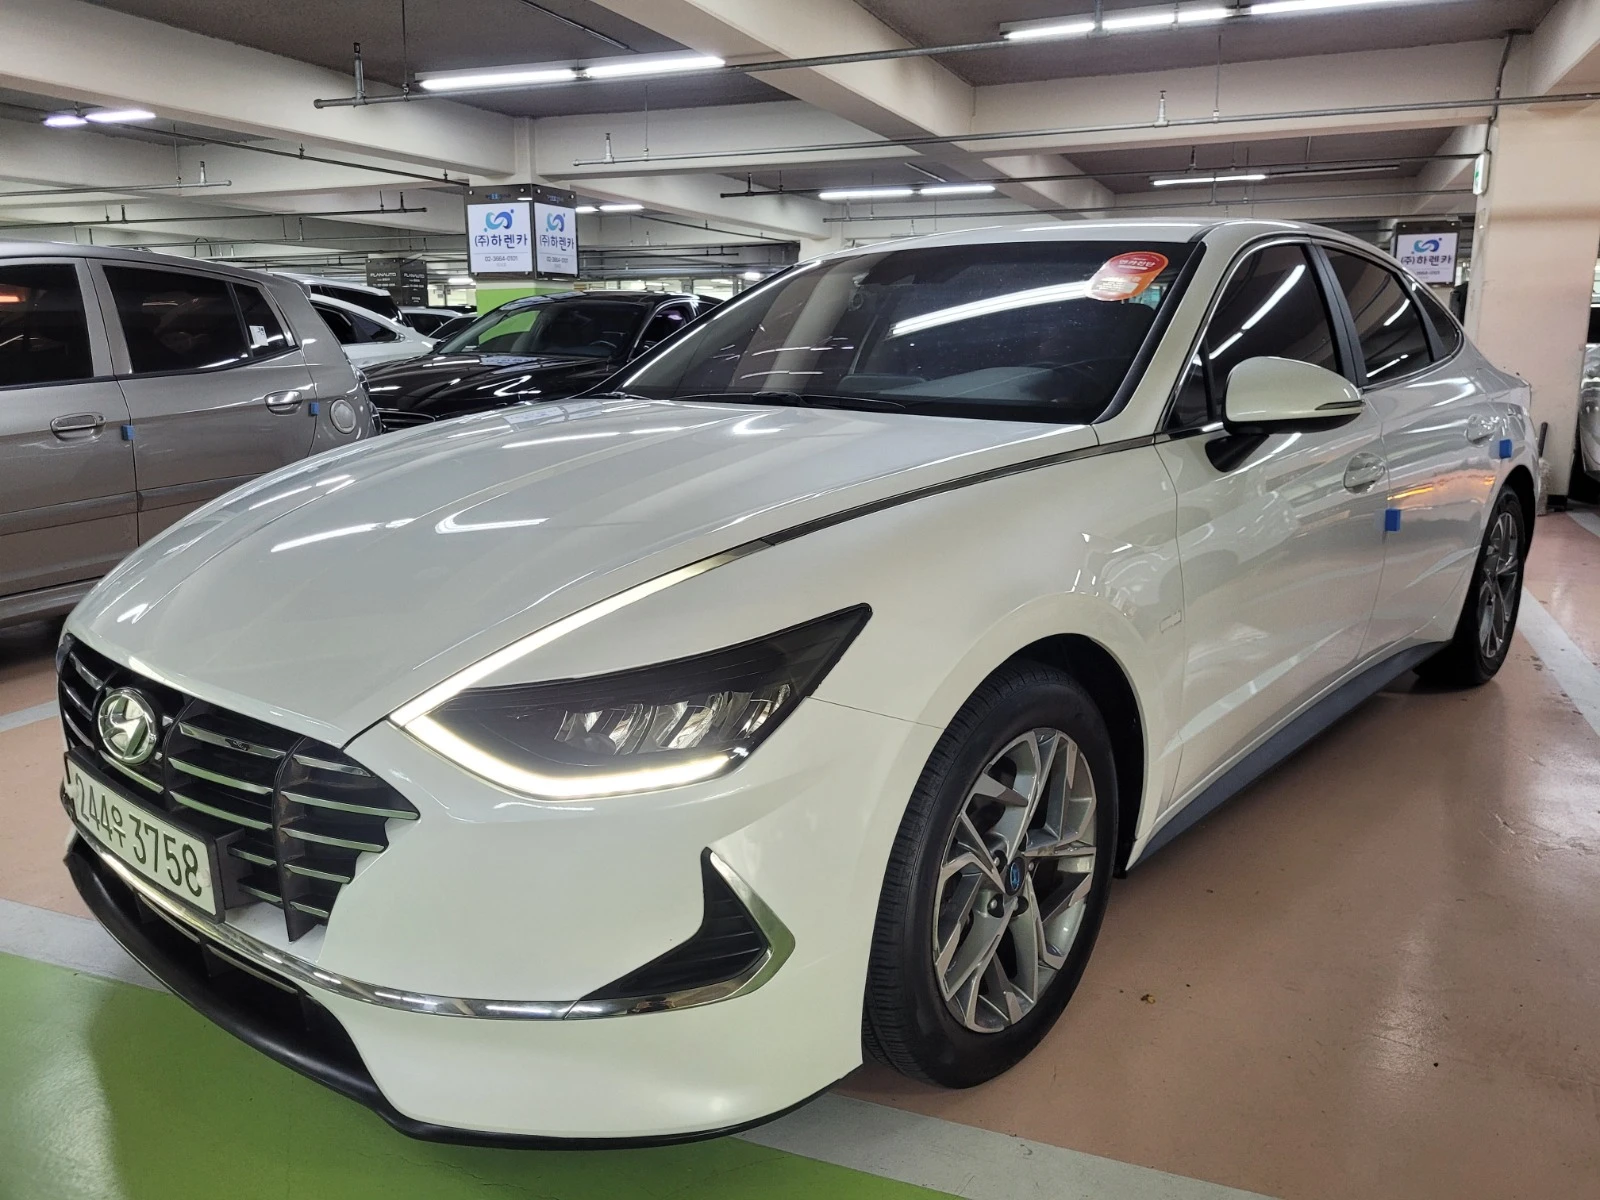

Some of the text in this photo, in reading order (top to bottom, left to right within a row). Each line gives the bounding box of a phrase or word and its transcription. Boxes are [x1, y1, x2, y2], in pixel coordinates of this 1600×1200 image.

[474, 234, 528, 249] (주)하렌카
[540, 234, 574, 251] (주)하렌카
[1401, 254, 1452, 266] (주)하렌카
